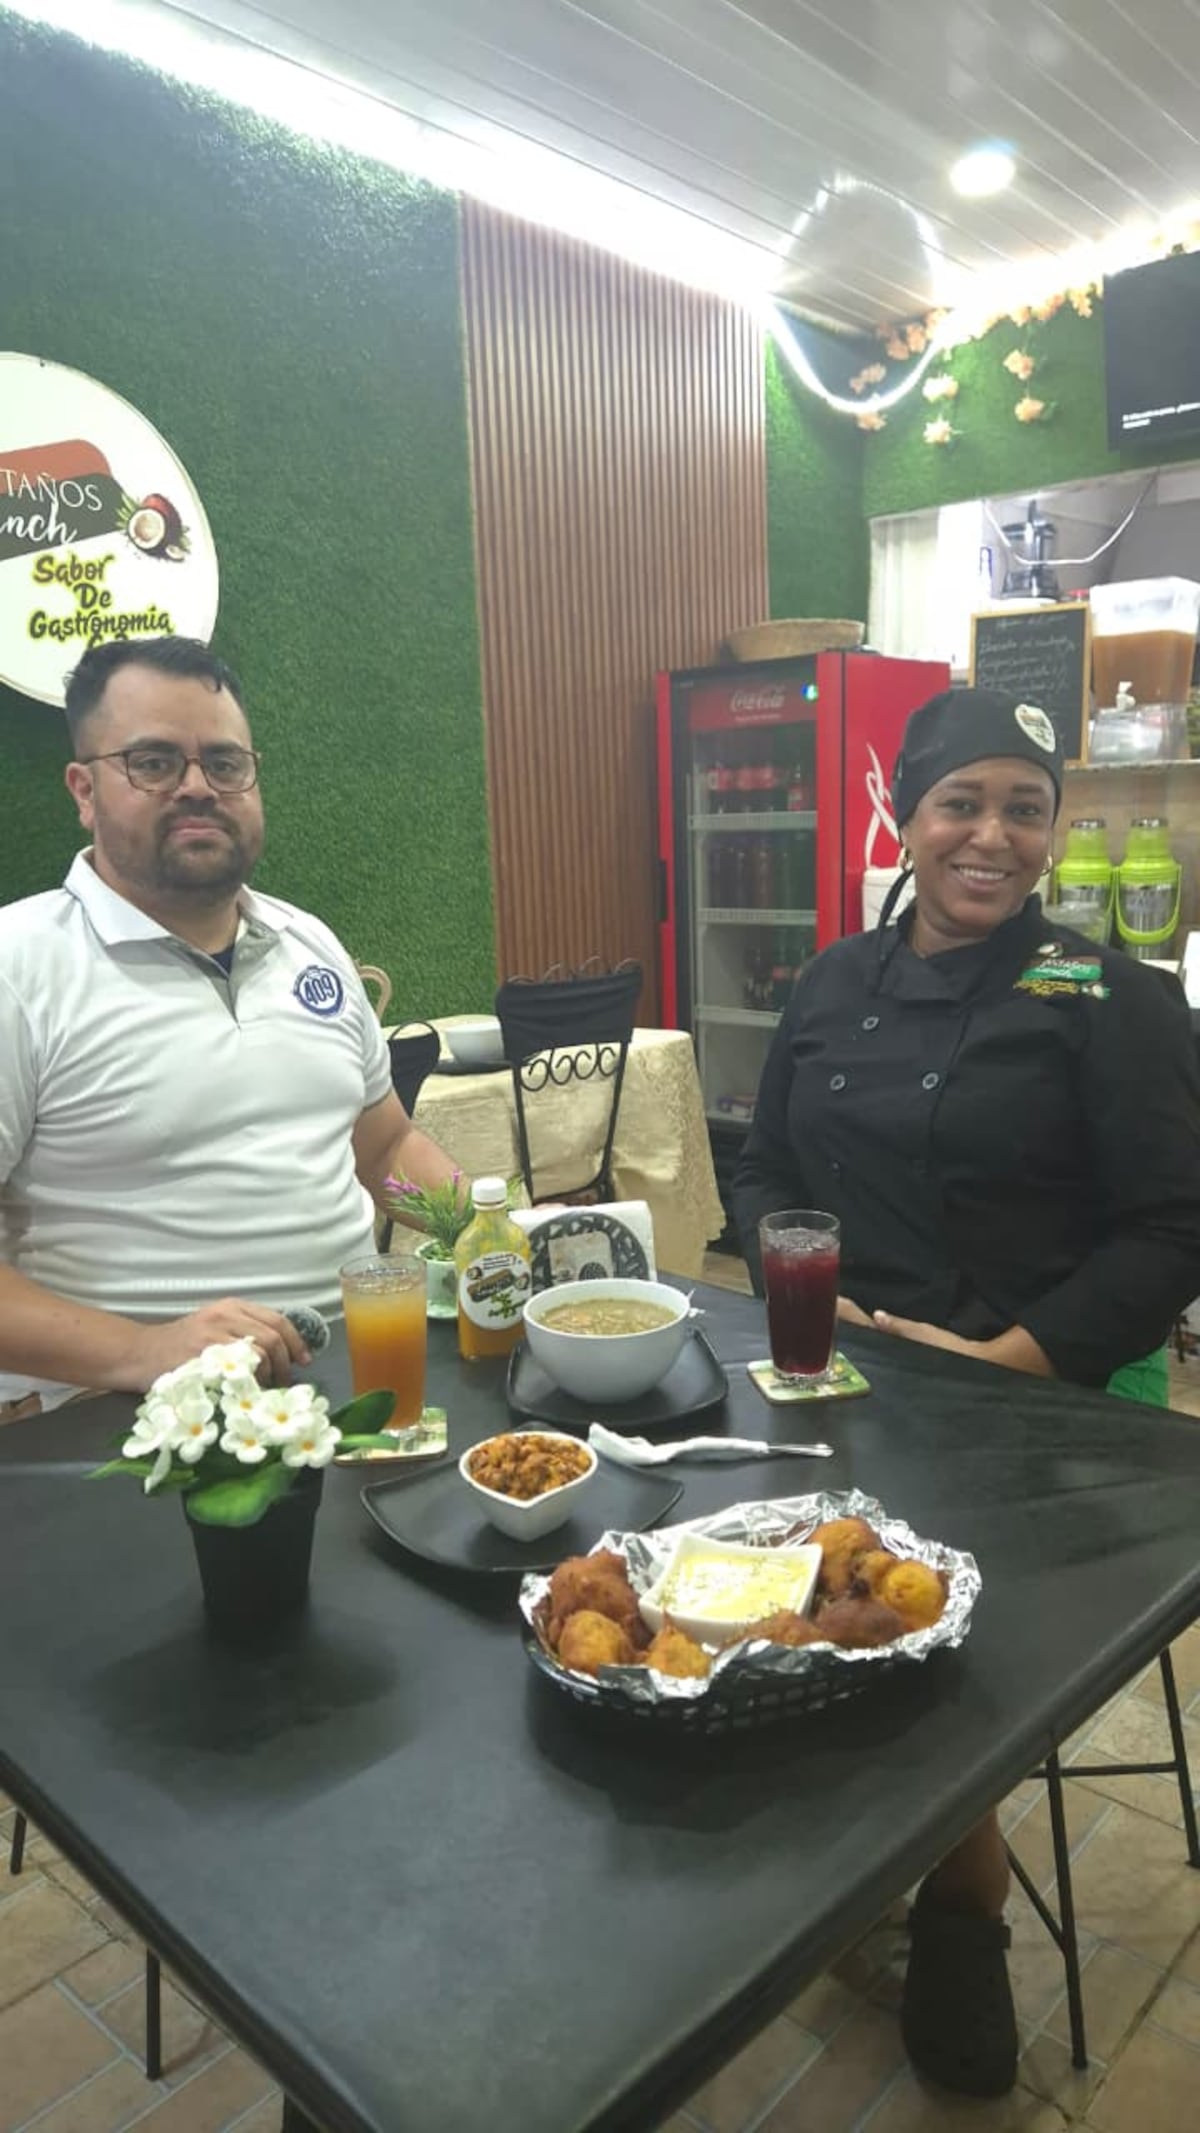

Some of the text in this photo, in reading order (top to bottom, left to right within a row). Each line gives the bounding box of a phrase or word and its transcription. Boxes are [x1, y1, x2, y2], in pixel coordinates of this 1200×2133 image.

[34, 553, 114, 586] Sabor
[73, 583, 112, 609] De
[304, 974, 335, 1005] 409
